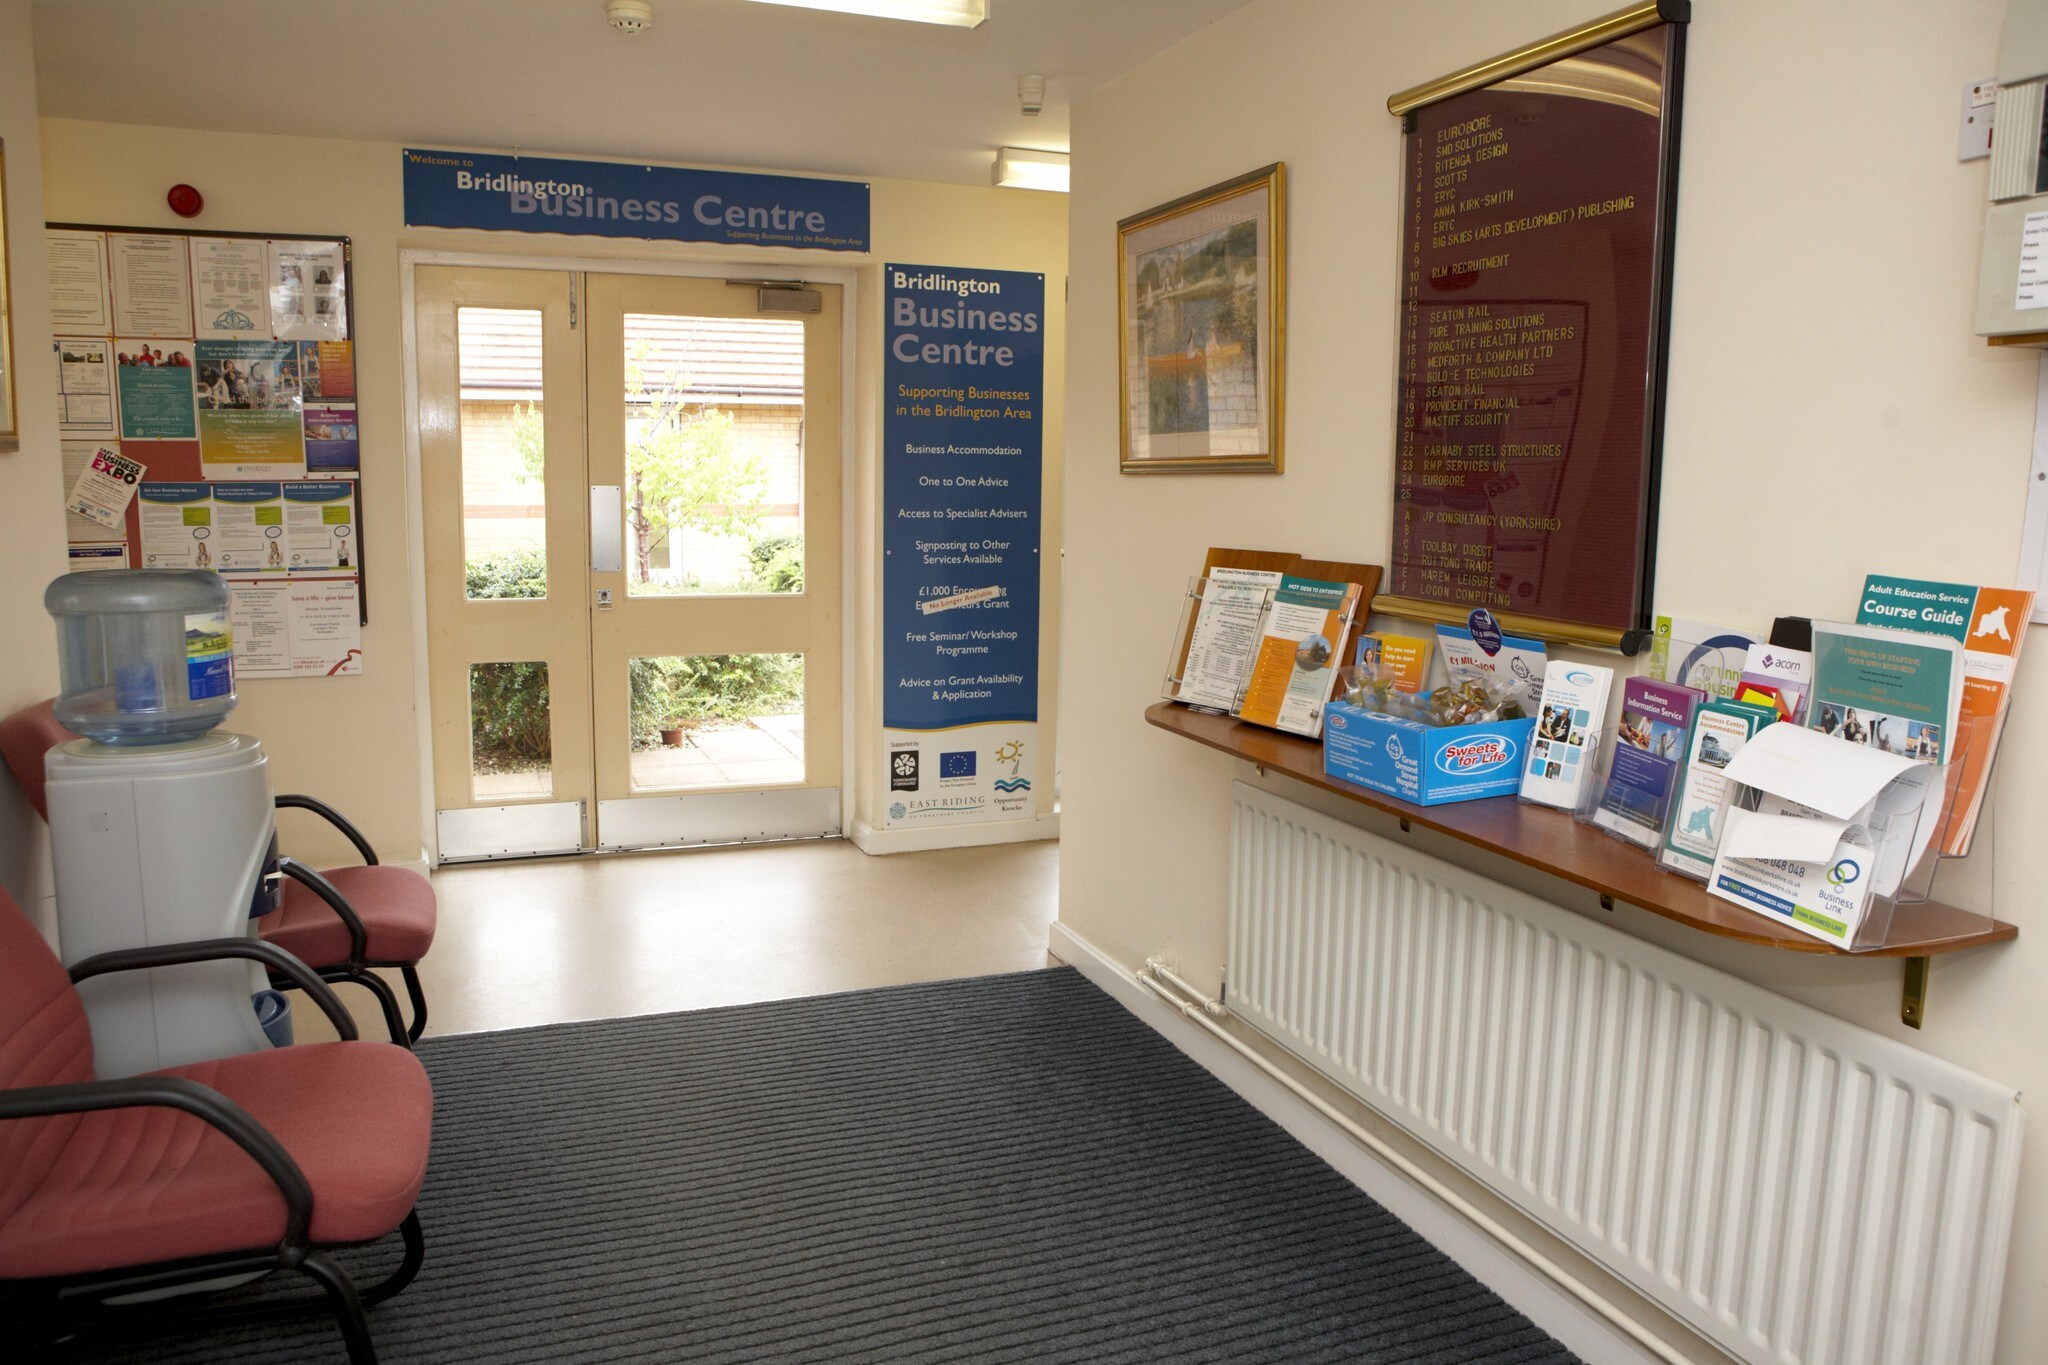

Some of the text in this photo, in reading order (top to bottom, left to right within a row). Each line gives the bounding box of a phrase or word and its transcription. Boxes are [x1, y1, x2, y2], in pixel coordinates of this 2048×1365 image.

[1437, 115, 1492, 143] EUROBORE
[1436, 128, 1504, 158] SMD SOLUTIONS
[410, 155, 459, 166] Welcome
[1435, 143, 1508, 174] RITENGA DESIGN
[457, 171, 584, 199] Bridlington
[1434, 170, 1467, 188] SCOTTS
[1435, 188, 1456, 203] ERYC
[511, 187, 826, 233] Business Centre
[1434, 189, 1514, 219] ANNA KIRK-SMITH
[1432, 235, 1446, 249] BIG
[1448, 230, 1472, 246] SKIES
[1475, 223, 1501, 241] (ARTS
[1578, 195, 1634, 220] PUBLISHING
[1433, 219, 1455, 234] ERYC
[726, 230, 759, 240] Supporting
[762, 232, 793, 240] Businesses
[815, 236, 846, 246] Bridlington
[1432, 254, 1509, 279] RLM RECRUITMENT
[894, 272, 1000, 296] Bridlington
[894, 297, 1037, 333] Business
[1430, 305, 1490, 323] SEATON RAIL
[1429, 313, 1545, 338] PURE TRAINING SOLUTIONS
[1428, 326, 1574, 353] PROACTIVE HEALTH PARTNERS
[893, 334, 1013, 366] Centre
[1428, 346, 1553, 368] MEDFORTH & COMPANY LTD
[1465, 363, 1535, 379] TECHNOLOGIES
[899, 385, 1029, 401] Supporting Businesses
[1426, 383, 1485, 398] SEATON RAIL
[1425, 396, 1520, 412] PROVIDENT FINANCIAL
[896, 405, 1031, 421] in the Bridlington Area
[1425, 413, 1510, 427] MASTIFF SECURITY
[906, 444, 1021, 455] Business Accommodation
[1424, 444, 1562, 457] CARNABY STEEL STRUCTURES
[96, 451, 140, 476] BUSINESS
[1424, 460, 1506, 472] RMP SERVICES UK
[919, 476, 1009, 487] One to One Advice
[1423, 475, 1465, 487] EUROBORE
[898, 508, 1027, 520] Access to Specialist Advisers
[1423, 511, 1561, 532] JP CONSULTANCY (YORKSHIRE)
[916, 540, 1010, 552] Signposting to Other
[1421, 540, 1493, 557] TOOLBAY DIRECT
[924, 554, 1002, 564] Services Available
[1440, 556, 1460, 570] TONG
[1464, 559, 1493, 573] TRADE
[1421, 569, 1495, 589] HAREM LEISURE
[919, 586, 950, 596] £1,000
[1319, 588, 1344, 596] ENTERPRISE
[1420, 583, 1511, 607] LOGON COMPUTING
[1868, 584, 1969, 604] Adult Education Service
[929, 602, 939, 610] No
[941, 596, 963, 609] Longer
[965, 589, 993, 602] Available
[983, 600, 1009, 609] Grant
[1864, 600, 1964, 625] Course Guide
[907, 632, 927, 642] Free
[971, 630, 1017, 641] Workshop
[937, 645, 988, 657] Programme
[1775, 658, 1800, 671] acorn
[900, 674, 1023, 687] Advice on Grant Availability
[932, 689, 992, 701] & Application
[1644, 691, 1668, 705] Business
[1628, 698, 1682, 721] Information Service
[1699, 720, 1745, 737] Accommodation
[1701, 714, 1745, 729] Business Centre
[1446, 742, 1498, 759] Sweets
[1395, 761, 1418, 773] Ormond
[1402, 756, 1418, 766] Great
[1458, 752, 1506, 767] for Life
[1396, 777, 1418, 790] Hospital
[1401, 770, 1418, 782] Street
[910, 796, 984, 808] EAST RIDING
[994, 796, 1027, 804] Opportunity
[1788, 862, 1806, 878] 048
[1818, 890, 1854, 910] Business
[1825, 902, 1842, 915] Link
